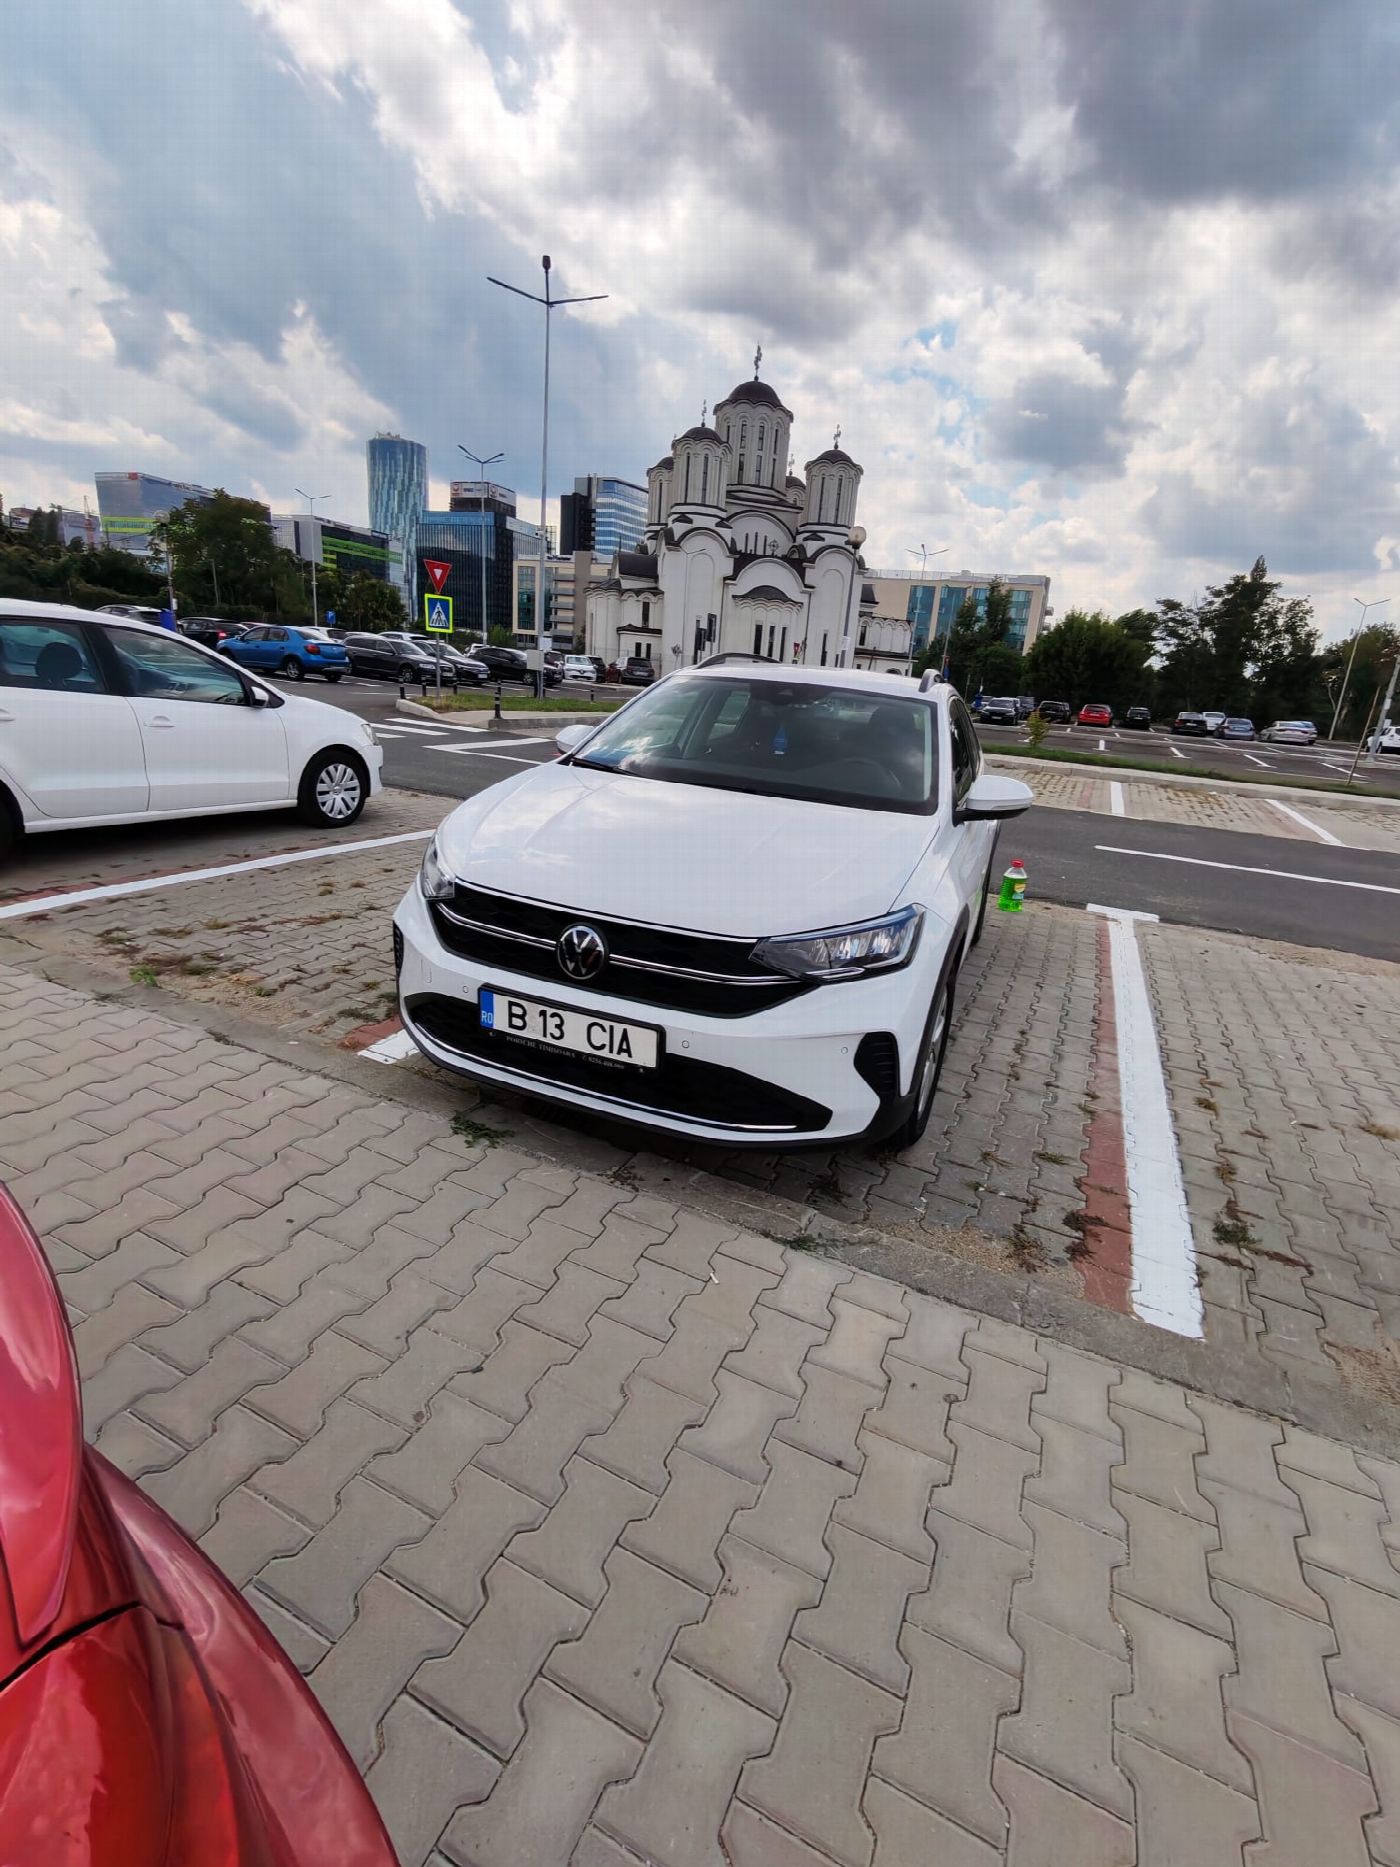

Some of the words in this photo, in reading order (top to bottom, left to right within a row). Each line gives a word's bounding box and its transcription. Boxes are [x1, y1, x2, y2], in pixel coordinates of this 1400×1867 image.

[481, 1010, 494, 1024] RO
[508, 1000, 528, 1031] B
[538, 1009, 565, 1041] 13
[586, 1021, 633, 1058] CIA
